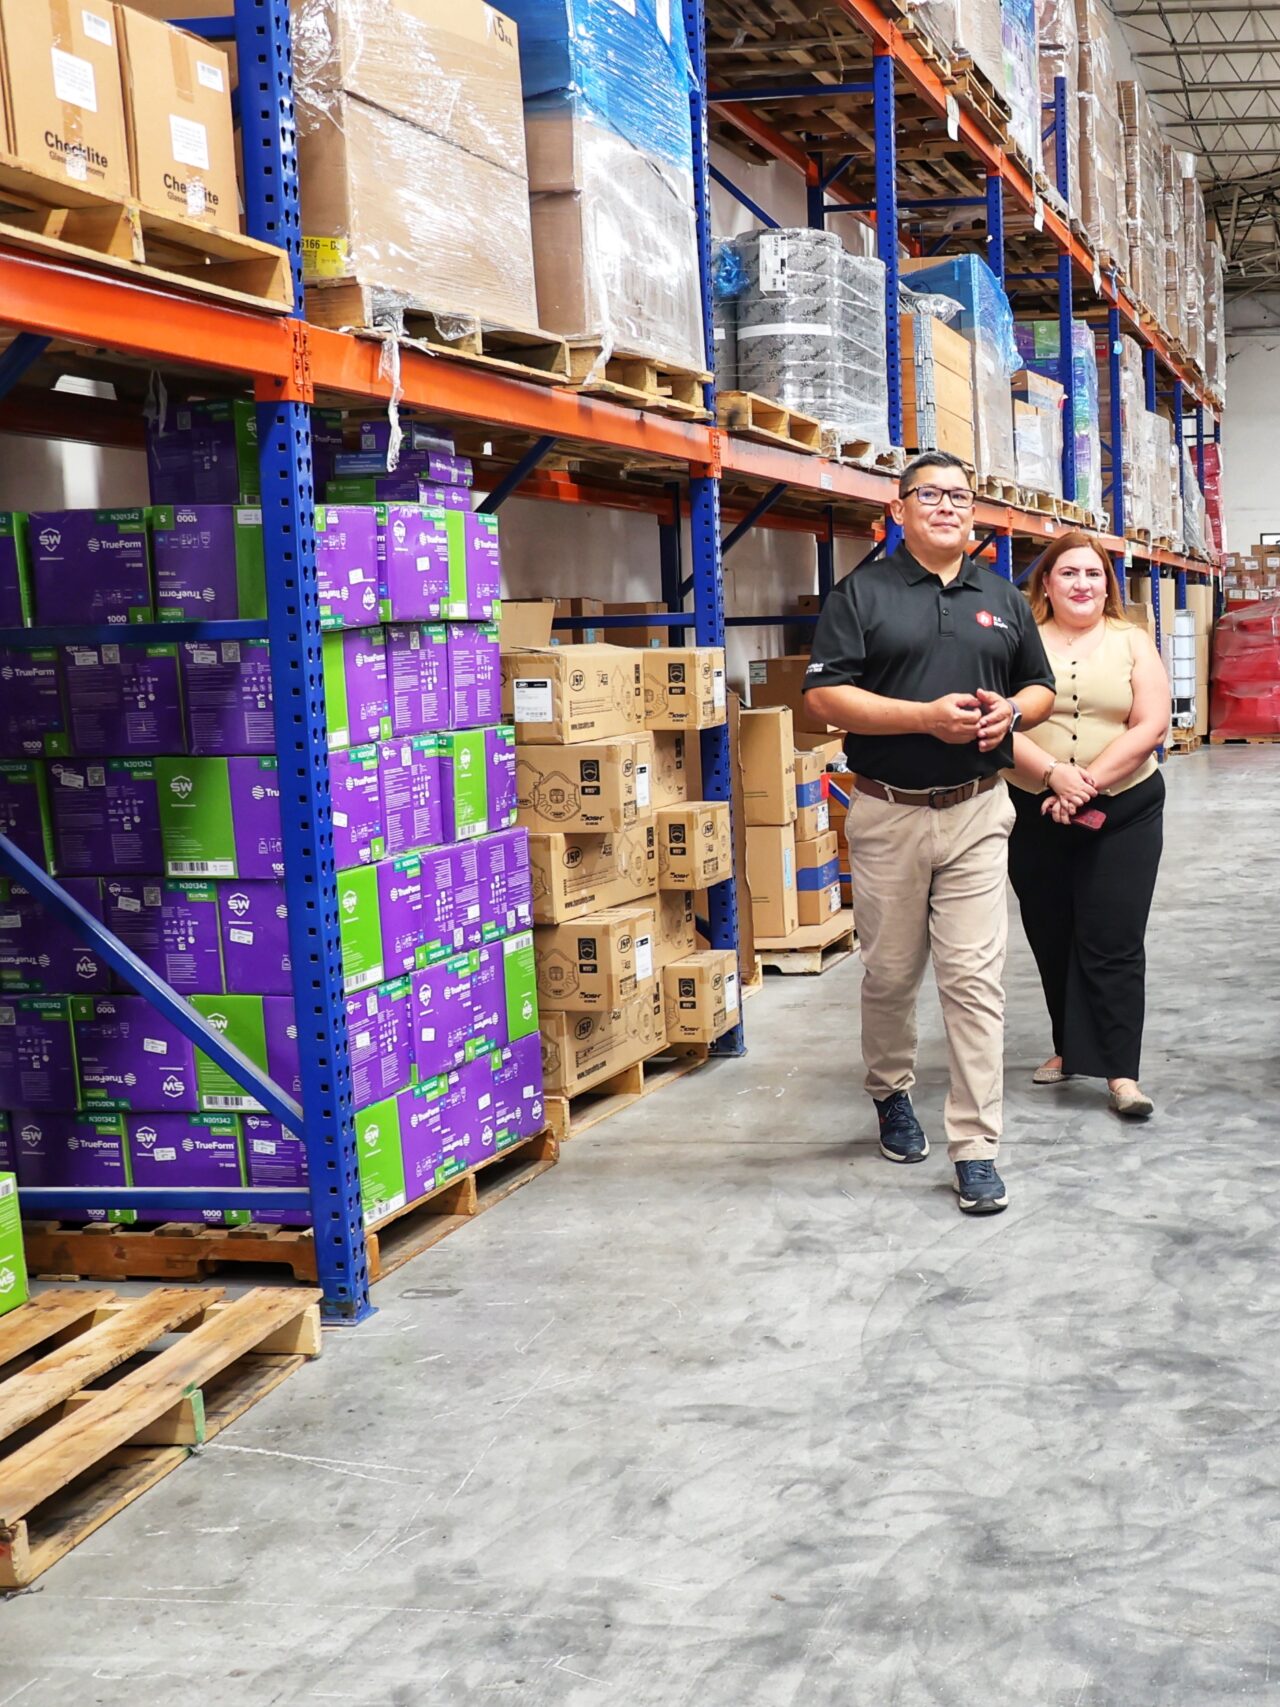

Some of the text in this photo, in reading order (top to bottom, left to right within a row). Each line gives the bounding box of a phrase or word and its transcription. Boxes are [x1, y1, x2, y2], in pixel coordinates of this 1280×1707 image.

[101, 540, 141, 549] TrueForm
[159, 590, 201, 599] TrueForm
[14, 668, 55, 677] TrueForm
[170, 782, 193, 793] SW
[227, 899, 250, 910] SW
[21, 1131, 42, 1141] SW
[135, 1132, 157, 1142] SW
[79, 1139, 119, 1149] TrueForm
[195, 1140, 235, 1150] TrueForm
